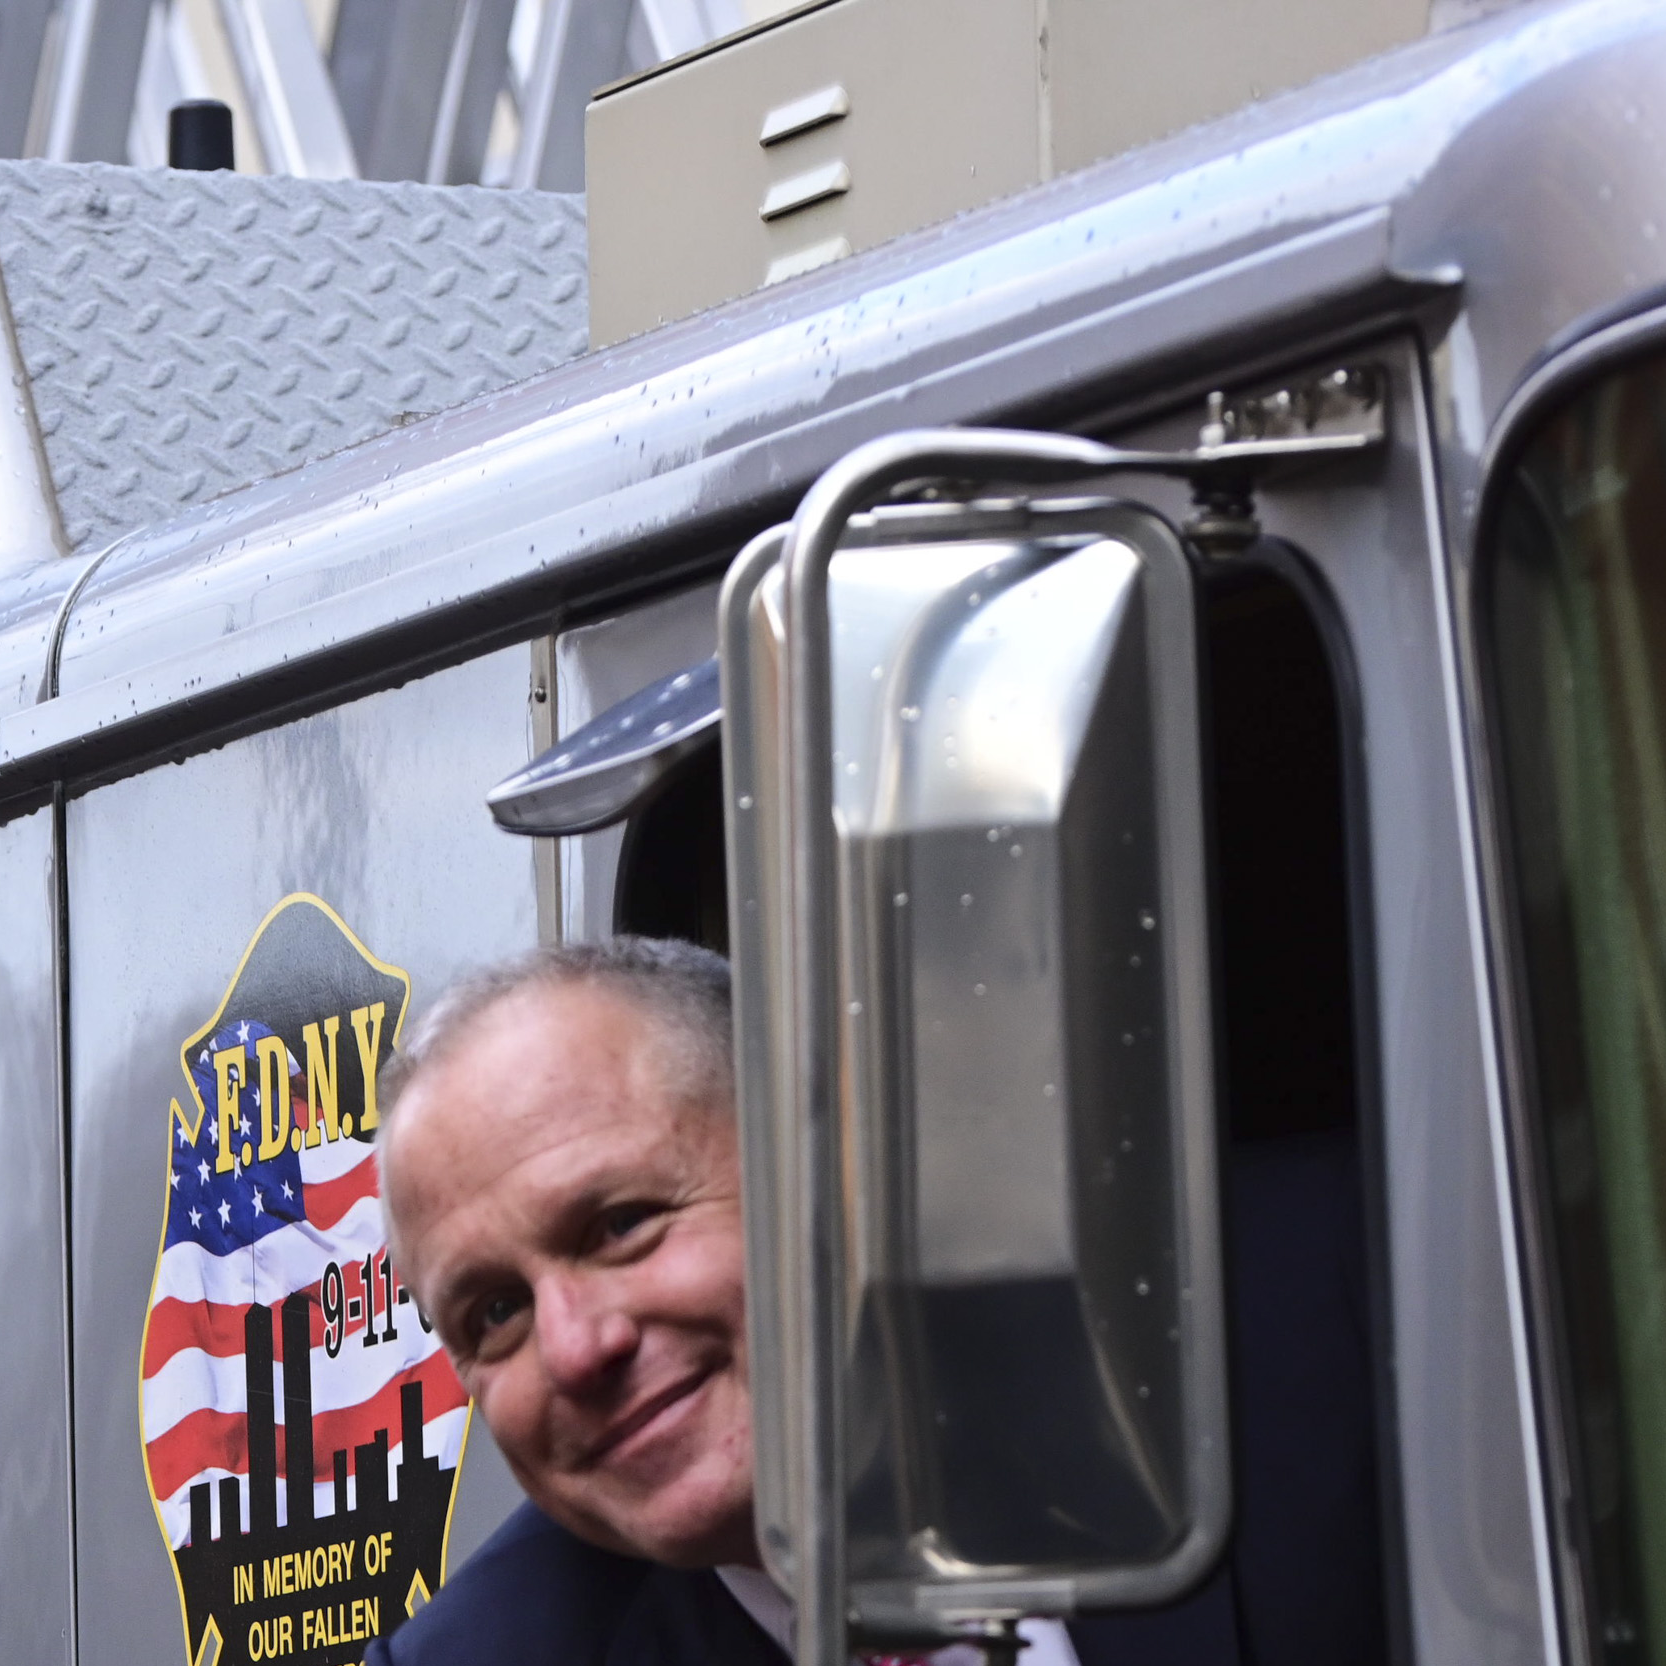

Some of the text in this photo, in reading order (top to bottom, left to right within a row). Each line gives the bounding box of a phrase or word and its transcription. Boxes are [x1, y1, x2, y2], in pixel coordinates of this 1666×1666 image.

[233, 1531, 393, 1605] IN MEMORY OF
[248, 1596, 380, 1662] OUR FALLEN
